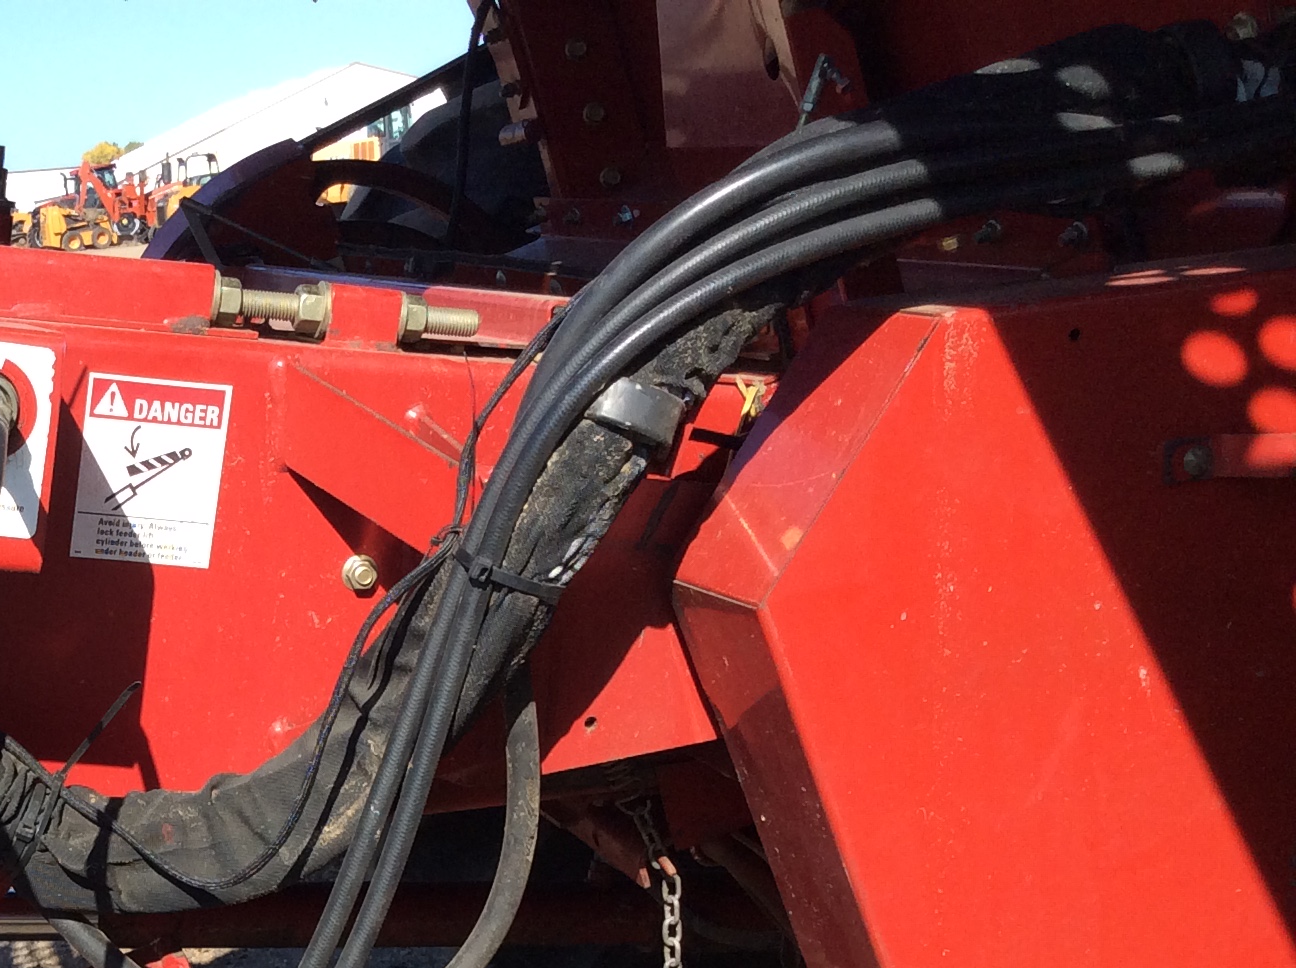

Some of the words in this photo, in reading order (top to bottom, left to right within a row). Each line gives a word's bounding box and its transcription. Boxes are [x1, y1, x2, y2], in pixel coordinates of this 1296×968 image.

[133, 398, 220, 427] DANGER
[98, 518, 121, 528] Avoid
[148, 522, 177, 532] Always
[96, 527, 114, 537] lock
[116, 529, 140, 539] feeder
[95, 538, 128, 547] cylinder
[129, 539, 154, 548] before
[95, 547, 118, 556] under
[119, 548, 146, 558] header
